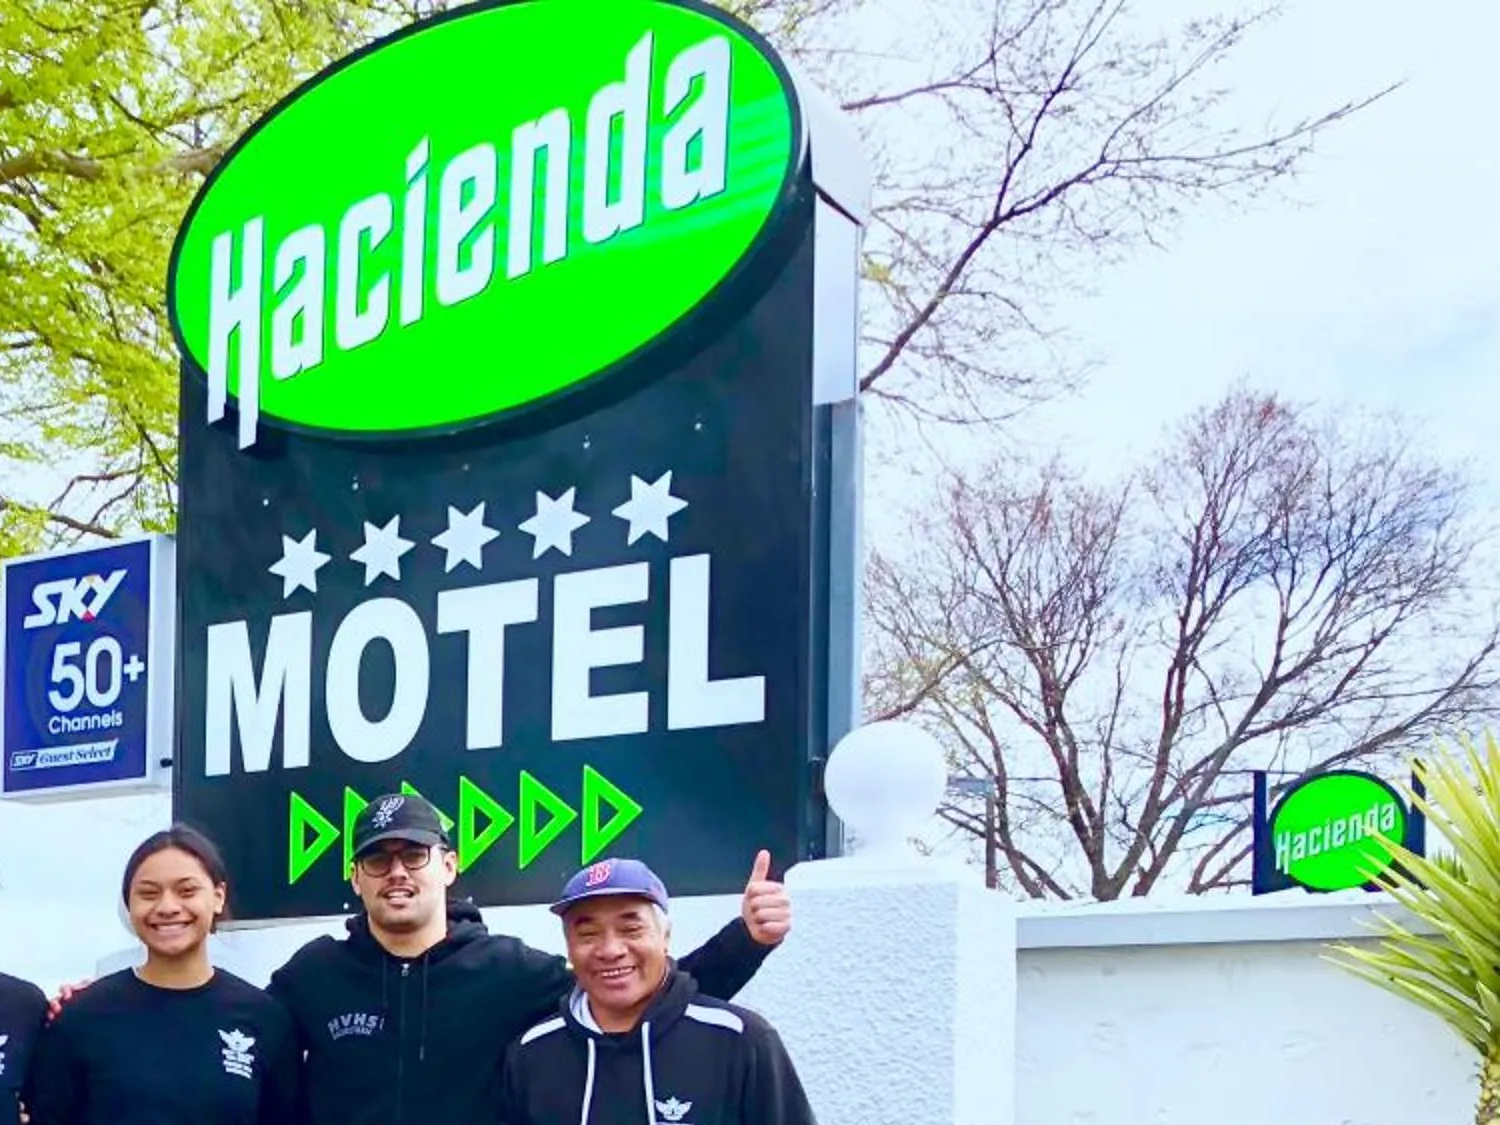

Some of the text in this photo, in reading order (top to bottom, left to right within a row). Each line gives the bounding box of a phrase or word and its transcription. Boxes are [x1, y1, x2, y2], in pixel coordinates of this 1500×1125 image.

[207, 31, 733, 451] Hacienda
[23, 569, 128, 629] SKY
[48, 635, 145, 712] 50+
[204, 553, 766, 778] MOTEL
[49, 709, 123, 735] Channels
[75, 745, 111, 762] Select
[1275, 801, 1396, 875] Hacienda
